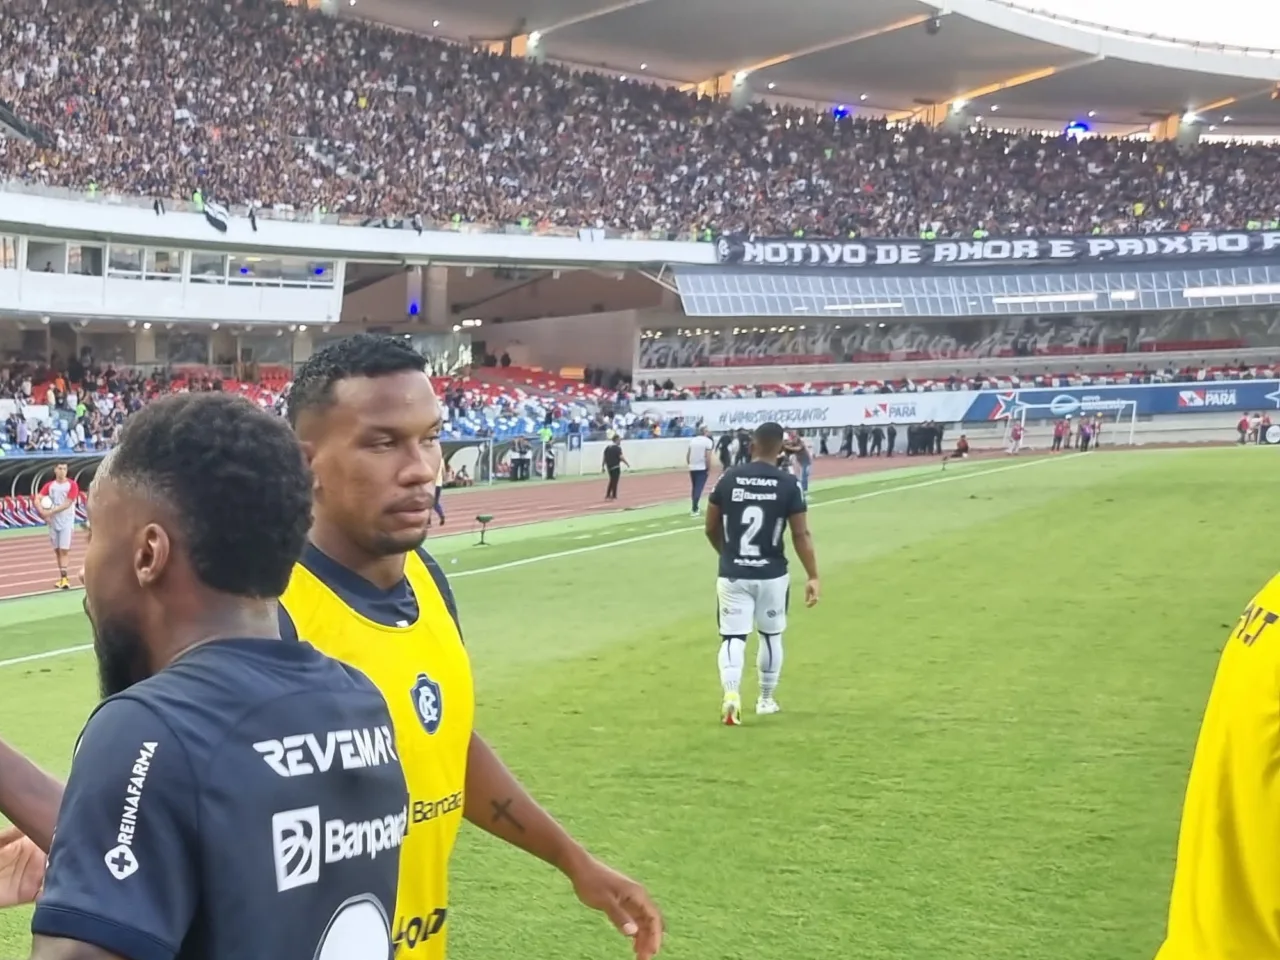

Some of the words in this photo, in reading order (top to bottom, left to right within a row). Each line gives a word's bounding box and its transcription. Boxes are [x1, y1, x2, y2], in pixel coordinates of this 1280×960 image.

[743, 241, 867, 264] MOTIVO
[874, 244, 922, 264] DE
[933, 240, 1038, 263] AMOR
[1050, 240, 1075, 258] E
[1086, 232, 1249, 257] PAIXÃO
[739, 505, 764, 557] 2
[253, 725, 398, 777] REVEMAR
[116, 741, 159, 846] REINAFARMA
